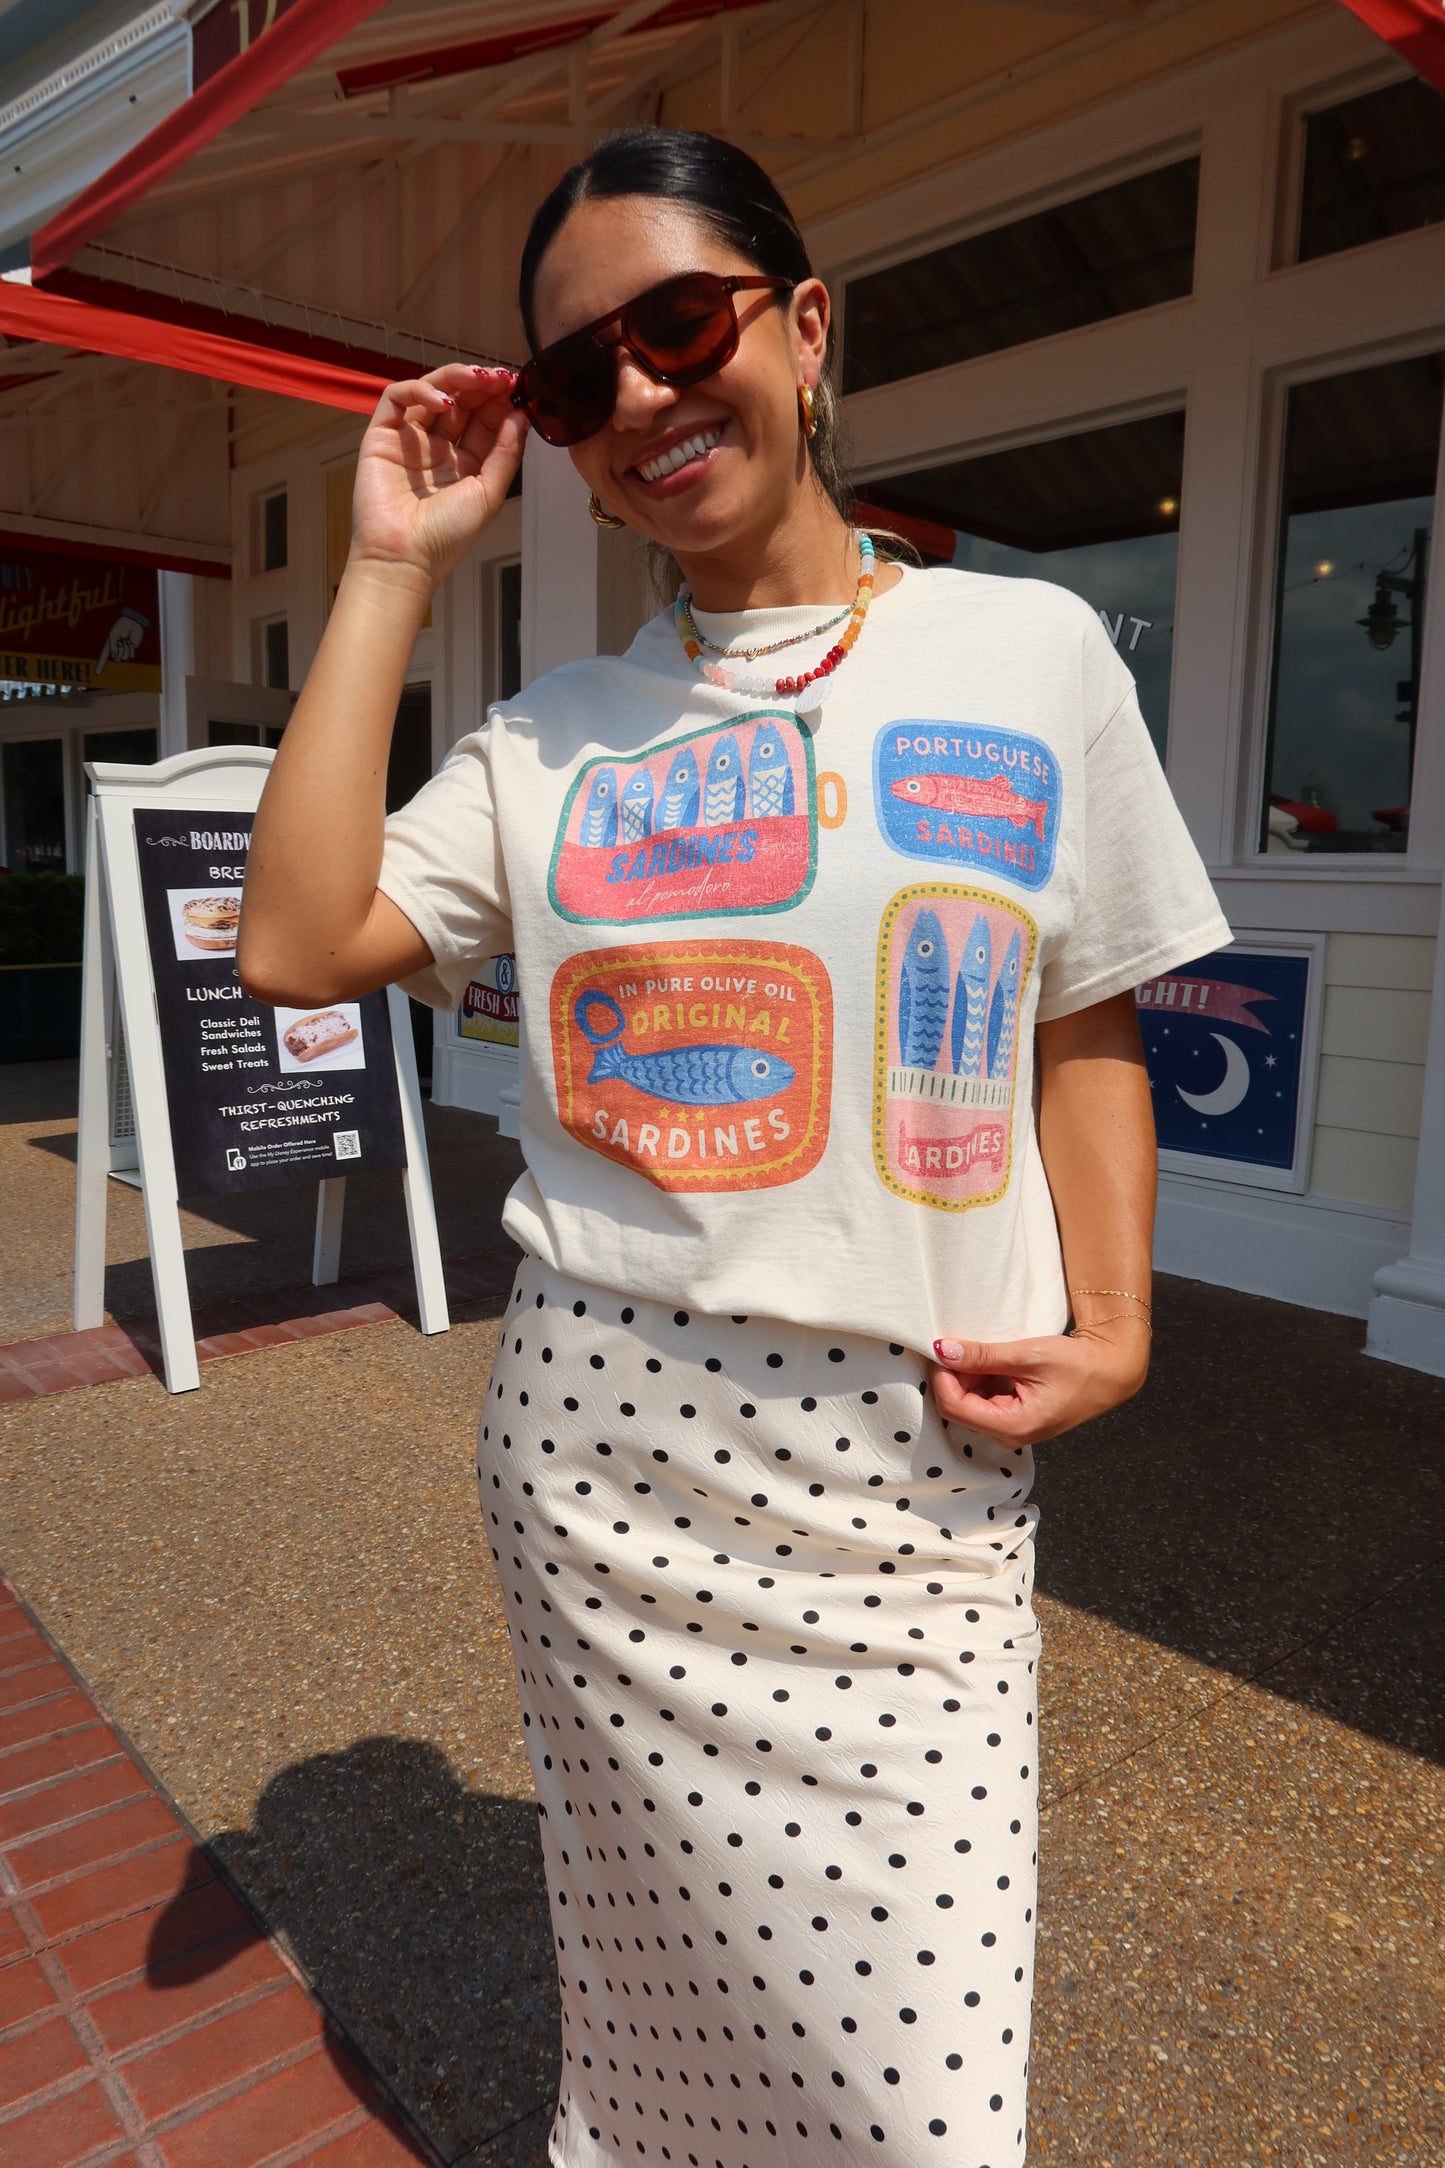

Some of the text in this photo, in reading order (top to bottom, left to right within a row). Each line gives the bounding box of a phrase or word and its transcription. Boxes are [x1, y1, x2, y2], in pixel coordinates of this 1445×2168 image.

[37, 658, 91, 683] HERE!
[896, 737, 1050, 785] PORTUGUESE
[605, 829, 760, 885] SARDINES
[916, 820, 1036, 873] SARDINES
[208, 866, 245, 880] BRE
[186, 986, 243, 1001] LUNCH
[468, 986, 500, 1015] FRESH
[618, 976, 796, 1002] IN PURE OLIVE OIL
[200, 1016, 260, 1029] Classic Deli
[201, 1028, 262, 1040] Sandwiches
[631, 1002, 792, 1044] ORIGINAL
[200, 1042, 266, 1056] Fresh Salads
[201, 1059, 269, 1072] Sweet Treats
[218, 1094, 355, 1117] THIRST-QUENCHING
[240, 1111, 341, 1131] REFRESHMENTS
[283, 1140, 304, 1148] Offered
[591, 1108, 791, 1159] SARDINES
